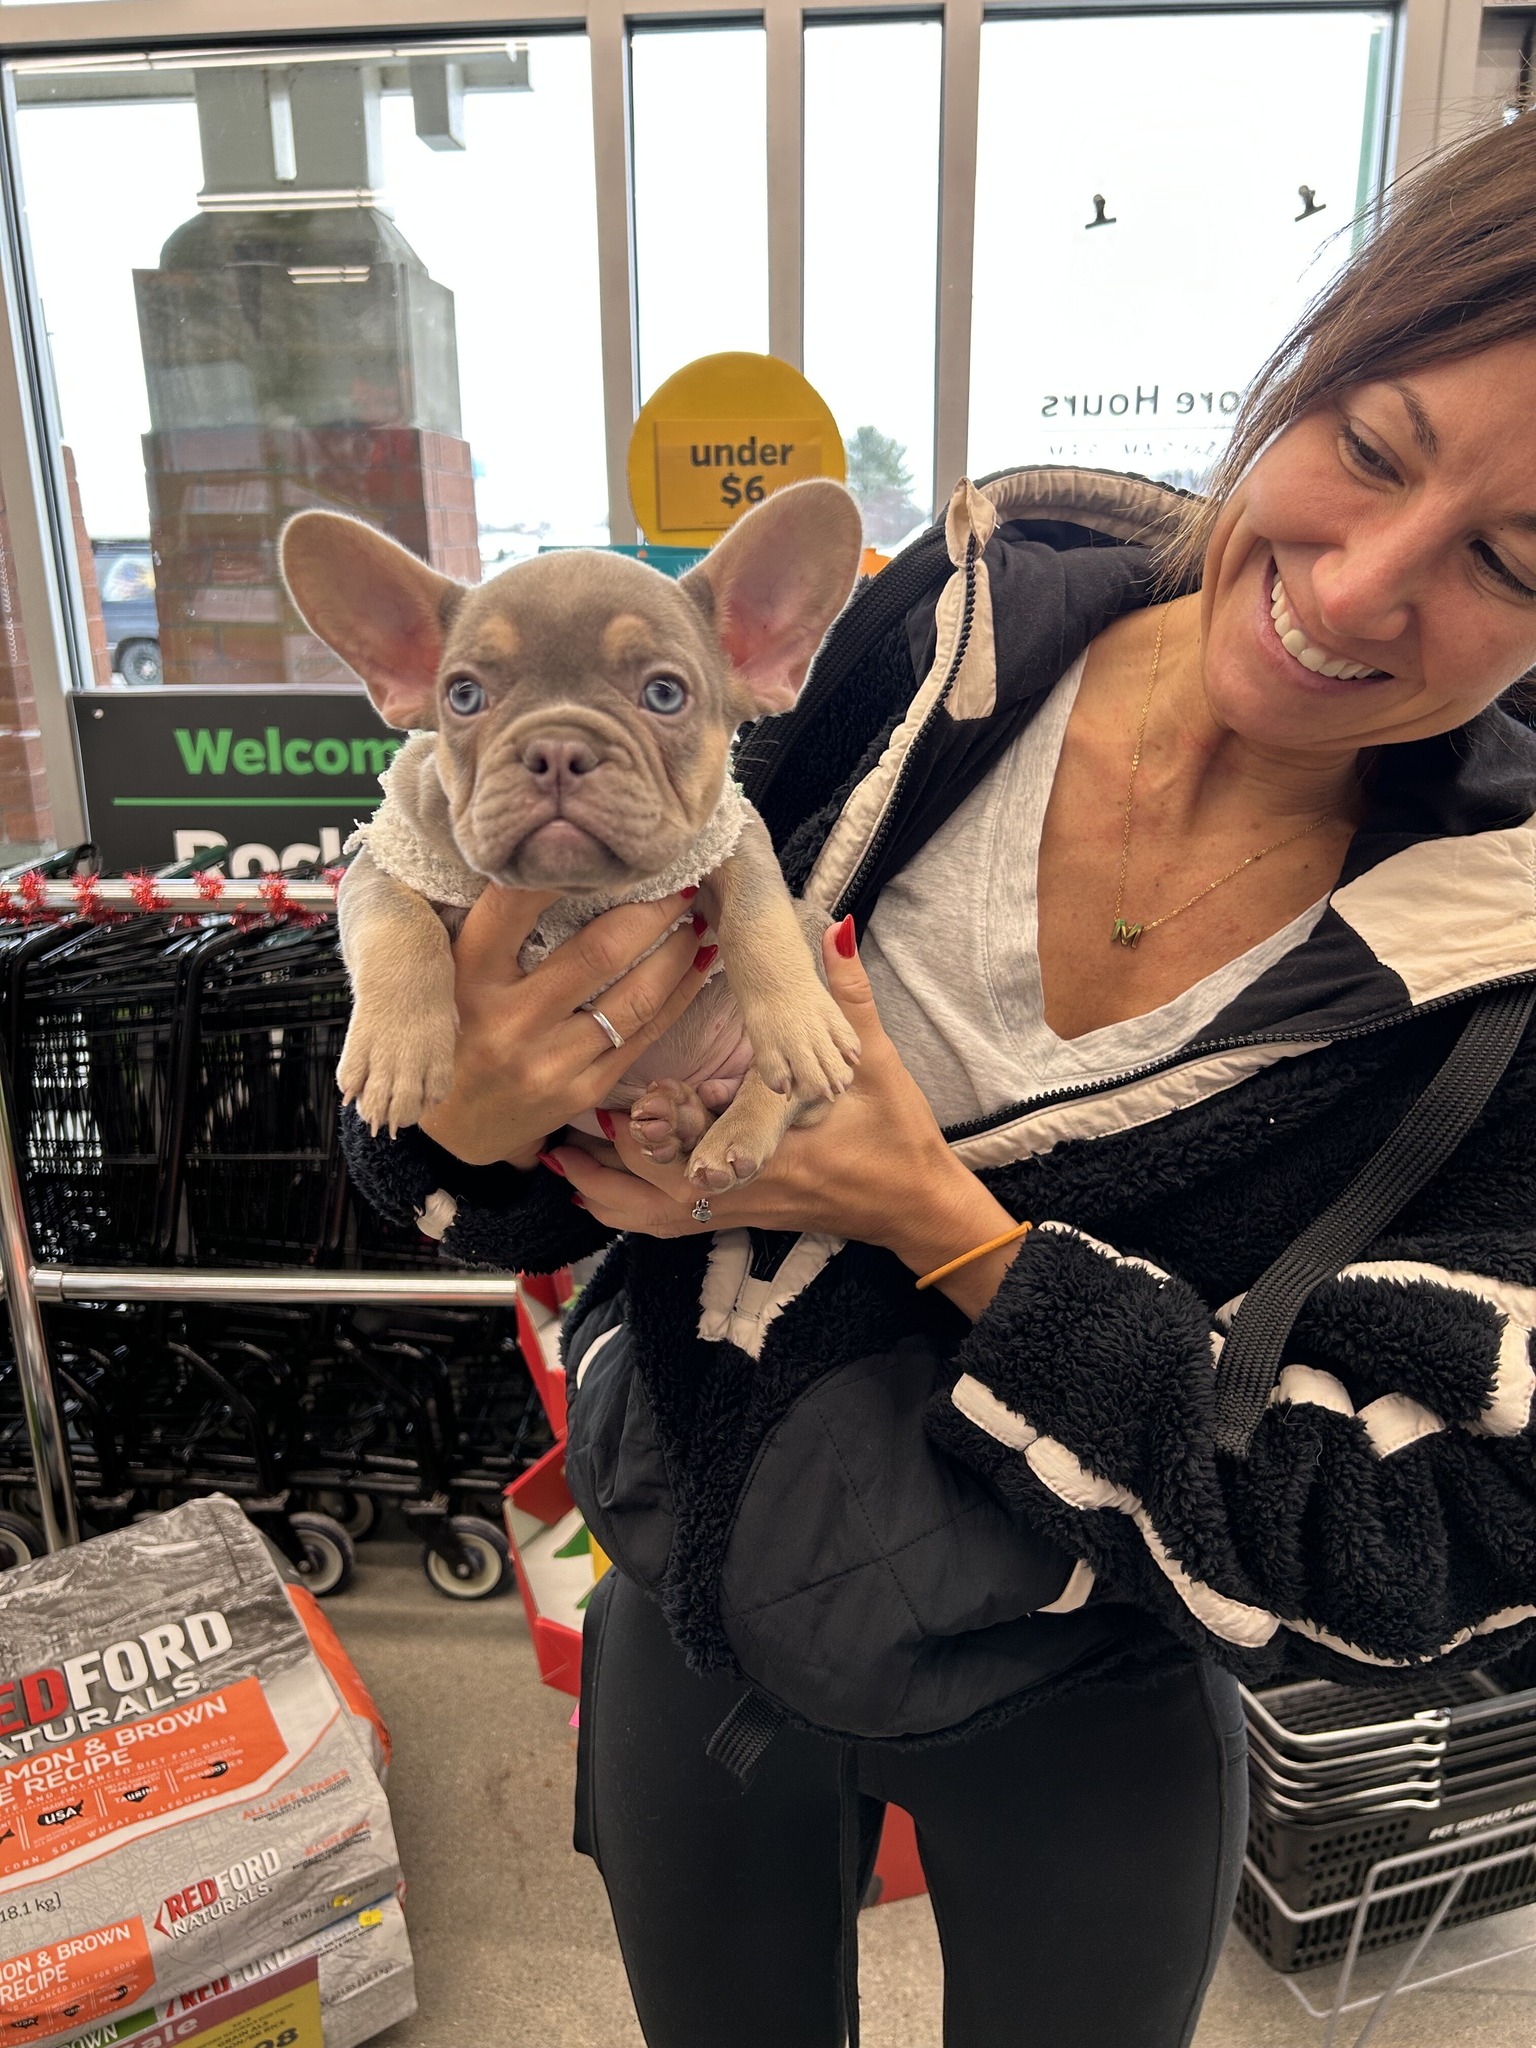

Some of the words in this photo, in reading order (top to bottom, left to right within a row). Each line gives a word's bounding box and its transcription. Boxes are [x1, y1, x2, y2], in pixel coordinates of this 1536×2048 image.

[690, 436, 794, 467] under
[721, 472, 765, 509] $6
[84, 1738, 107, 1756] &
[115, 1695, 227, 1747] BROWN
[23, 1747, 132, 1796] RECIPE
[114, 1786, 159, 1804] TAURINE
[45, 1806, 78, 1824] USA
[87, 1816, 130, 1839] WHEAT
[35, 1891, 62, 1913] kg)
[164, 1847, 281, 1923] REDFORD
[172, 1881, 270, 1939] NATURALS
[36, 1951, 52, 1969] &
[56, 1923, 131, 1961] BROWN
[0, 1962, 69, 2006] RECIPE
[117, 2017, 198, 2048] ale
